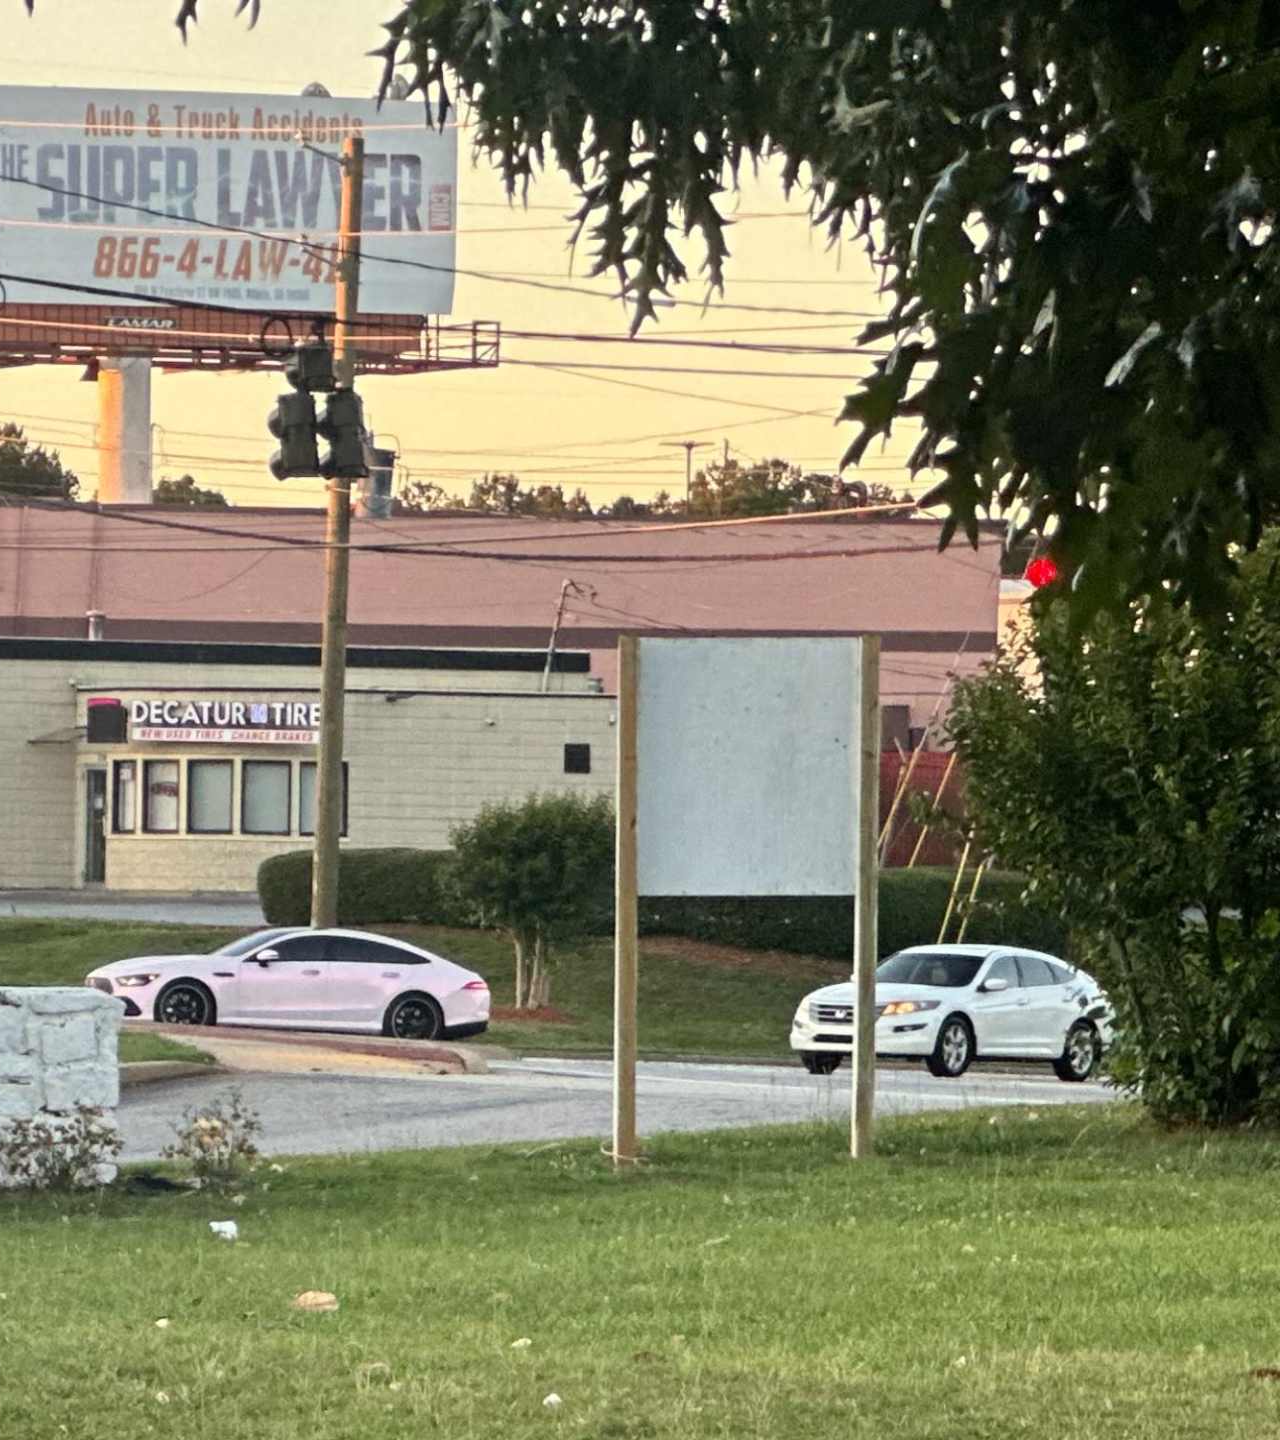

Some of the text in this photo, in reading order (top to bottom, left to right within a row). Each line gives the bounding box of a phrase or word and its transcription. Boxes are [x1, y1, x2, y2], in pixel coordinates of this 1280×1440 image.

[84, 102, 364, 144] Auto & Truck Accidents
[36, 144, 199, 223] SUPER
[131, 699, 246, 726] DECATUR
